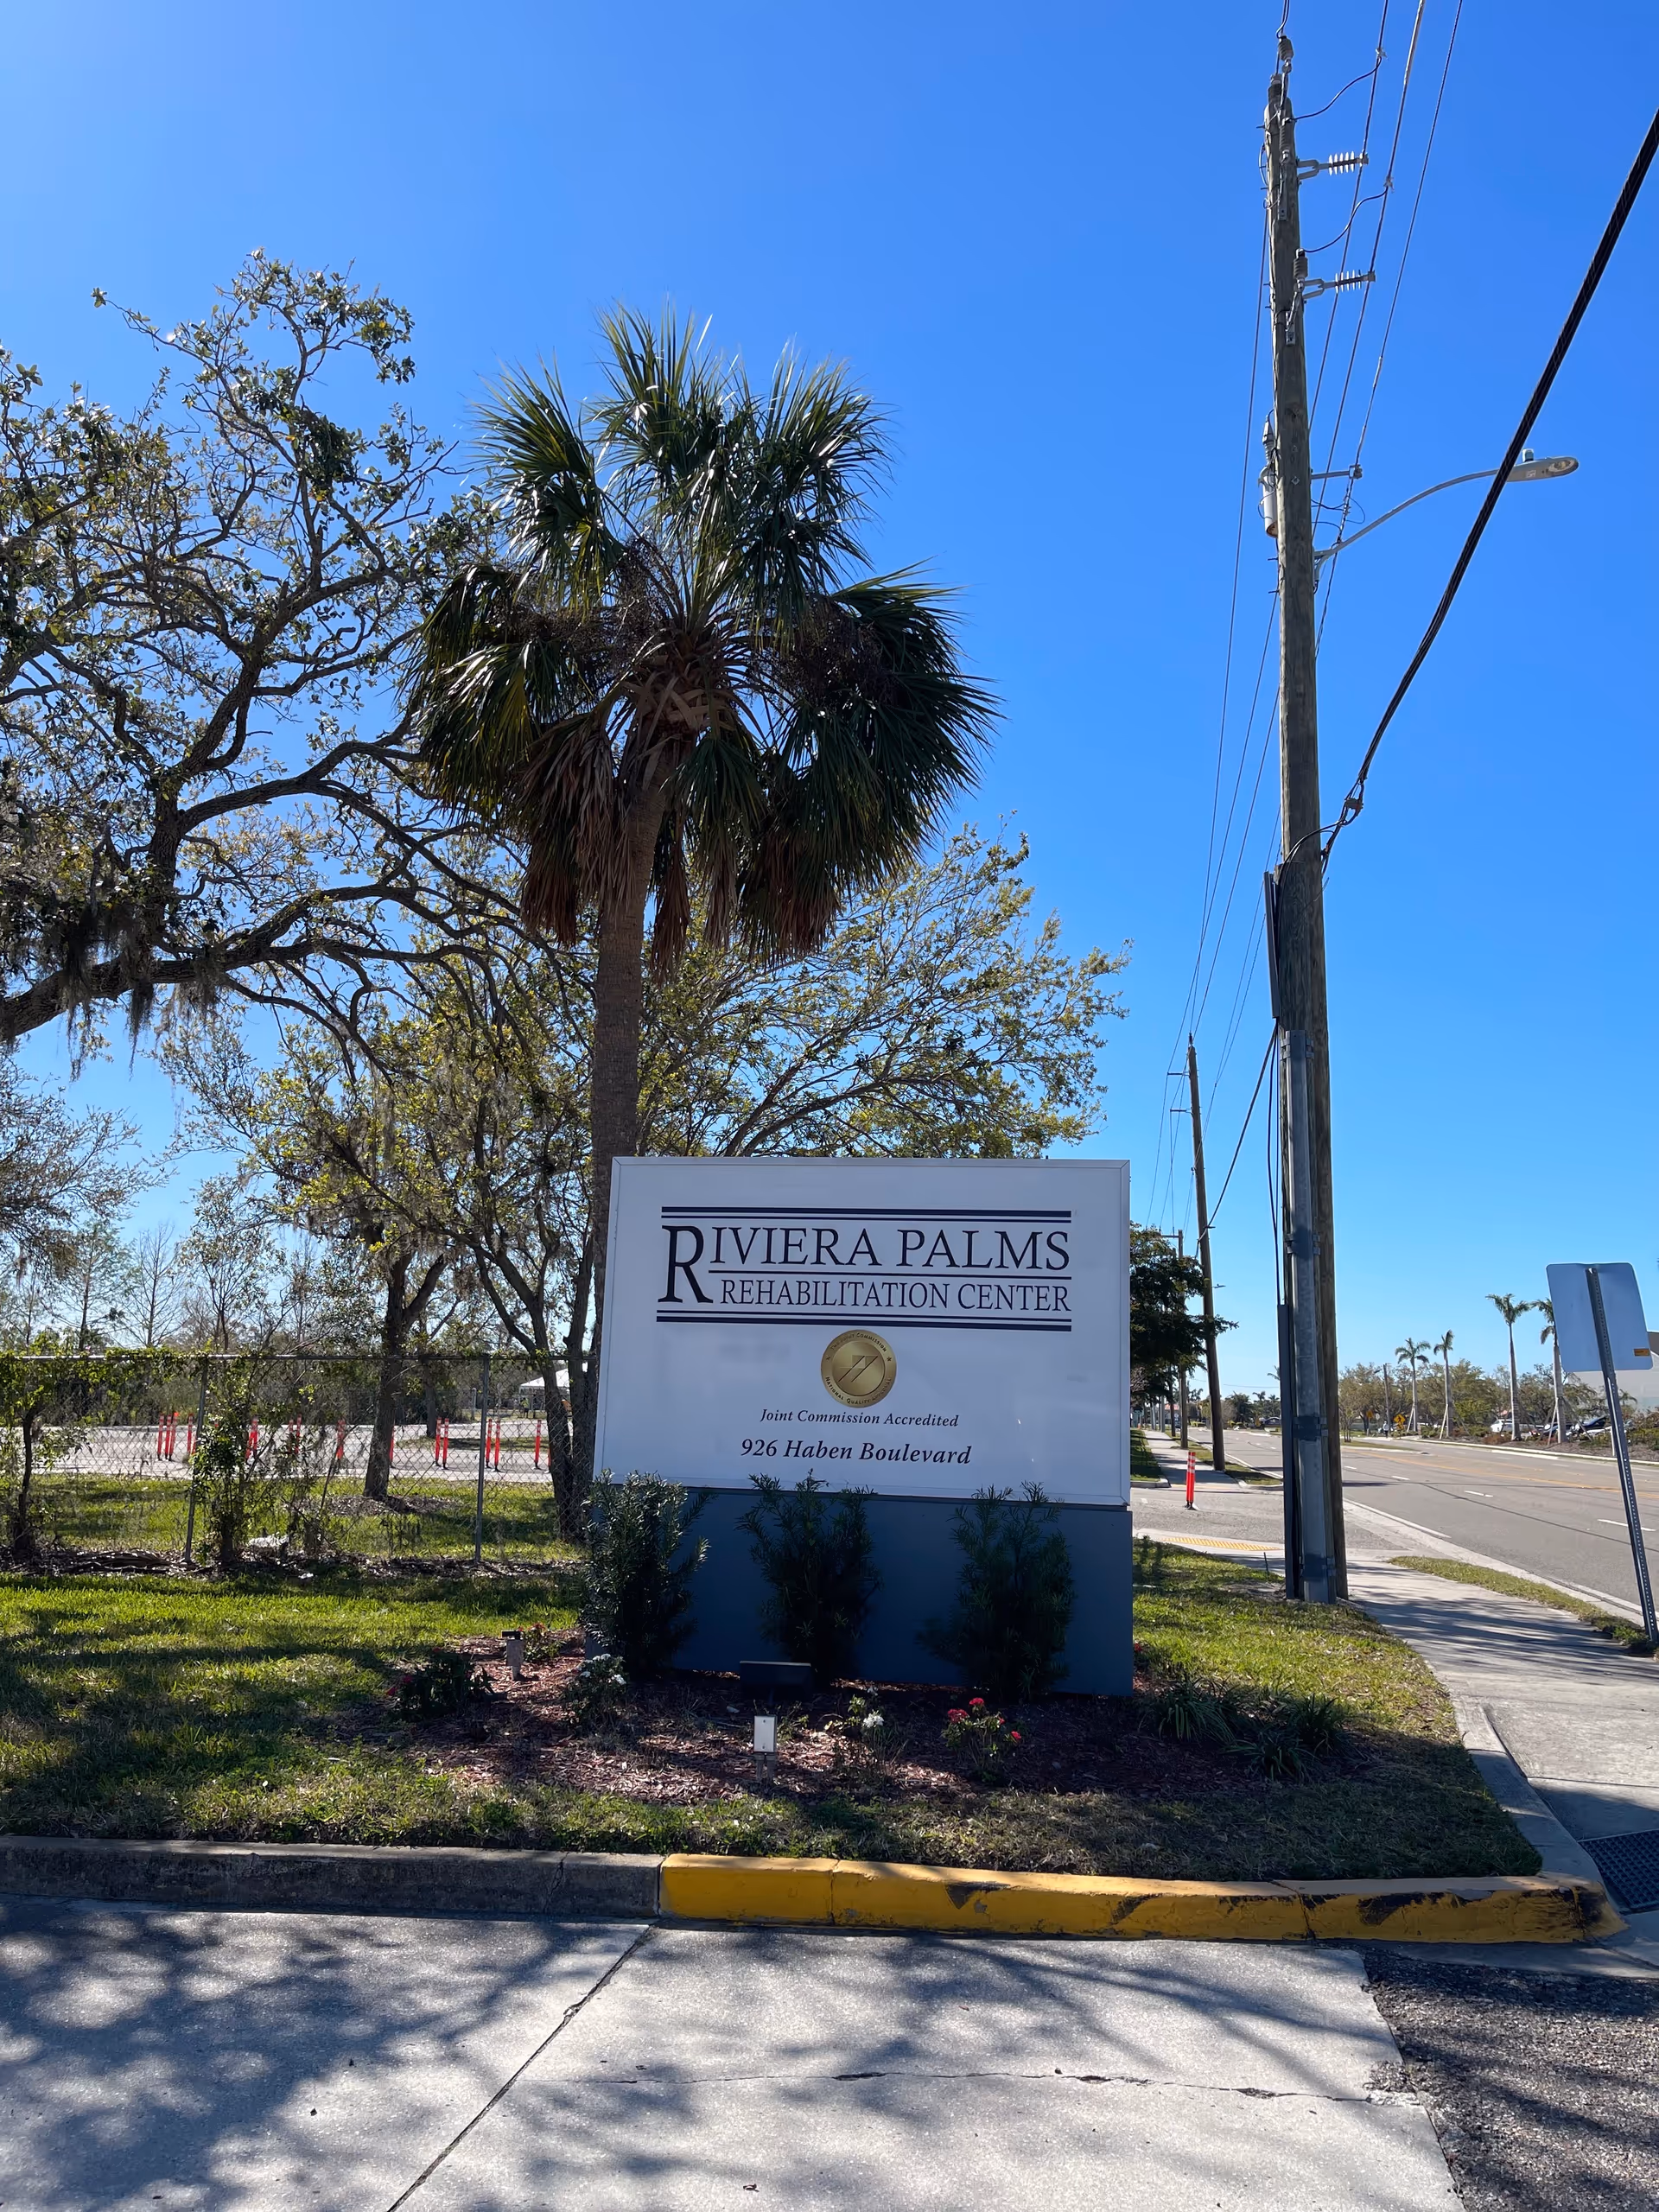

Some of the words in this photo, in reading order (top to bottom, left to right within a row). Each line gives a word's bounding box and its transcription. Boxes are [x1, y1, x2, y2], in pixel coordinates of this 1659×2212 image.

[658, 1224, 883, 1304] RIVIERA
[895, 1229, 1071, 1271] PALMS
[720, 1279, 950, 1310] REHABILITATION
[957, 1283, 1072, 1312] CENTER
[856, 1332, 887, 1352] COMMISSION
[825, 1376, 844, 1401] NATIONAL
[760, 1408, 794, 1422] Joint
[797, 1409, 880, 1425] Commission
[883, 1413, 959, 1427] Accredited
[741, 1438, 779, 1457] 926
[782, 1440, 853, 1460] Haben
[858, 1442, 972, 1465] Boulevard
